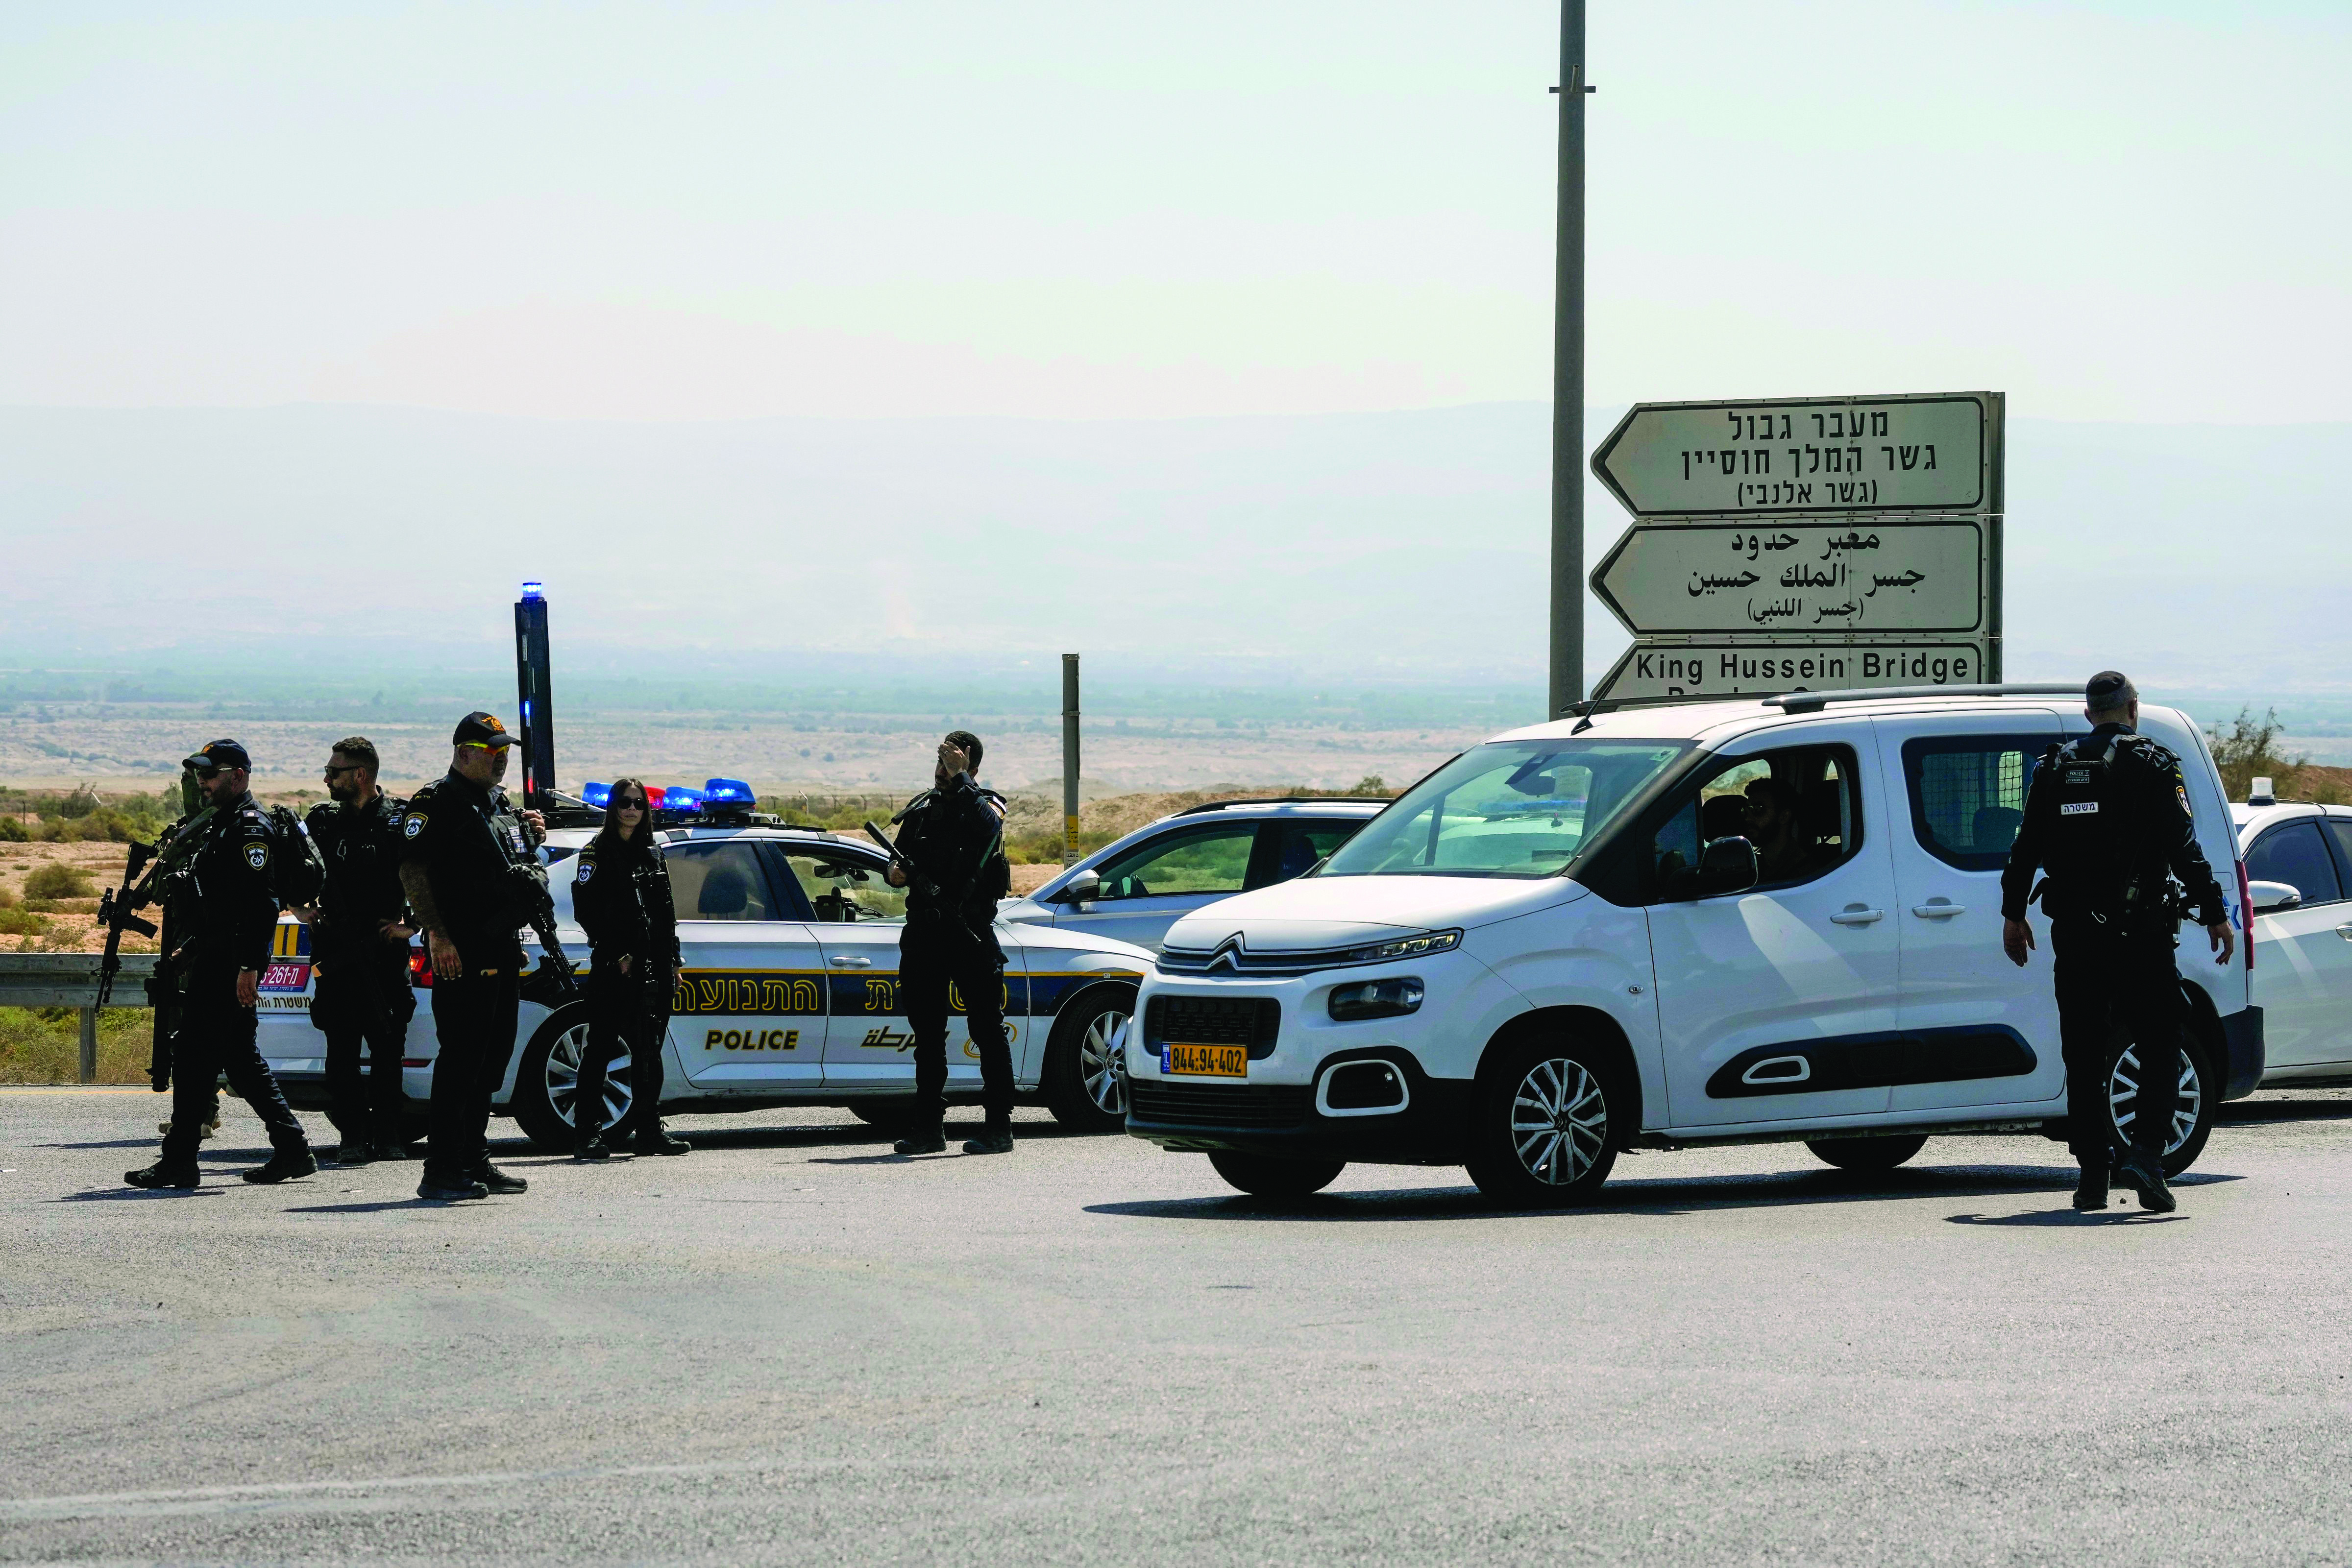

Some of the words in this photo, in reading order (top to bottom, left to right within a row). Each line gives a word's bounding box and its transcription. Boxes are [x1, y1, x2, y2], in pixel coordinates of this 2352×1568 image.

[1728, 411, 1792, 441] גבול
[1811, 411, 1888, 439] מעבר
[1681, 449, 1769, 481] חוסיין
[1788, 443, 1862, 478] המלך
[1881, 444, 1936, 471] גשר
[1738, 480, 1812, 507] אלנבי)
[1825, 479, 1877, 505] (גשר
[1732, 533, 1800, 561] حدود
[1819, 531, 1880, 560] معبر
[1688, 570, 1761, 597] حسين
[1780, 562, 1845, 588] الملك
[1864, 569, 1926, 598] جسر
[1747, 598, 1801, 625] اللنبي)
[1813, 598, 1864, 624] (جسر
[1637, 652, 1702, 685] King
[1720, 653, 1844, 679] Hussein
[1863, 652, 1968, 684] Bridge
[2064, 803, 2095, 813] משטרה
[273, 996, 310, 1008] משטרת
[672, 980, 818, 1011] התנועה
[705, 1029, 800, 1051] POLICE
